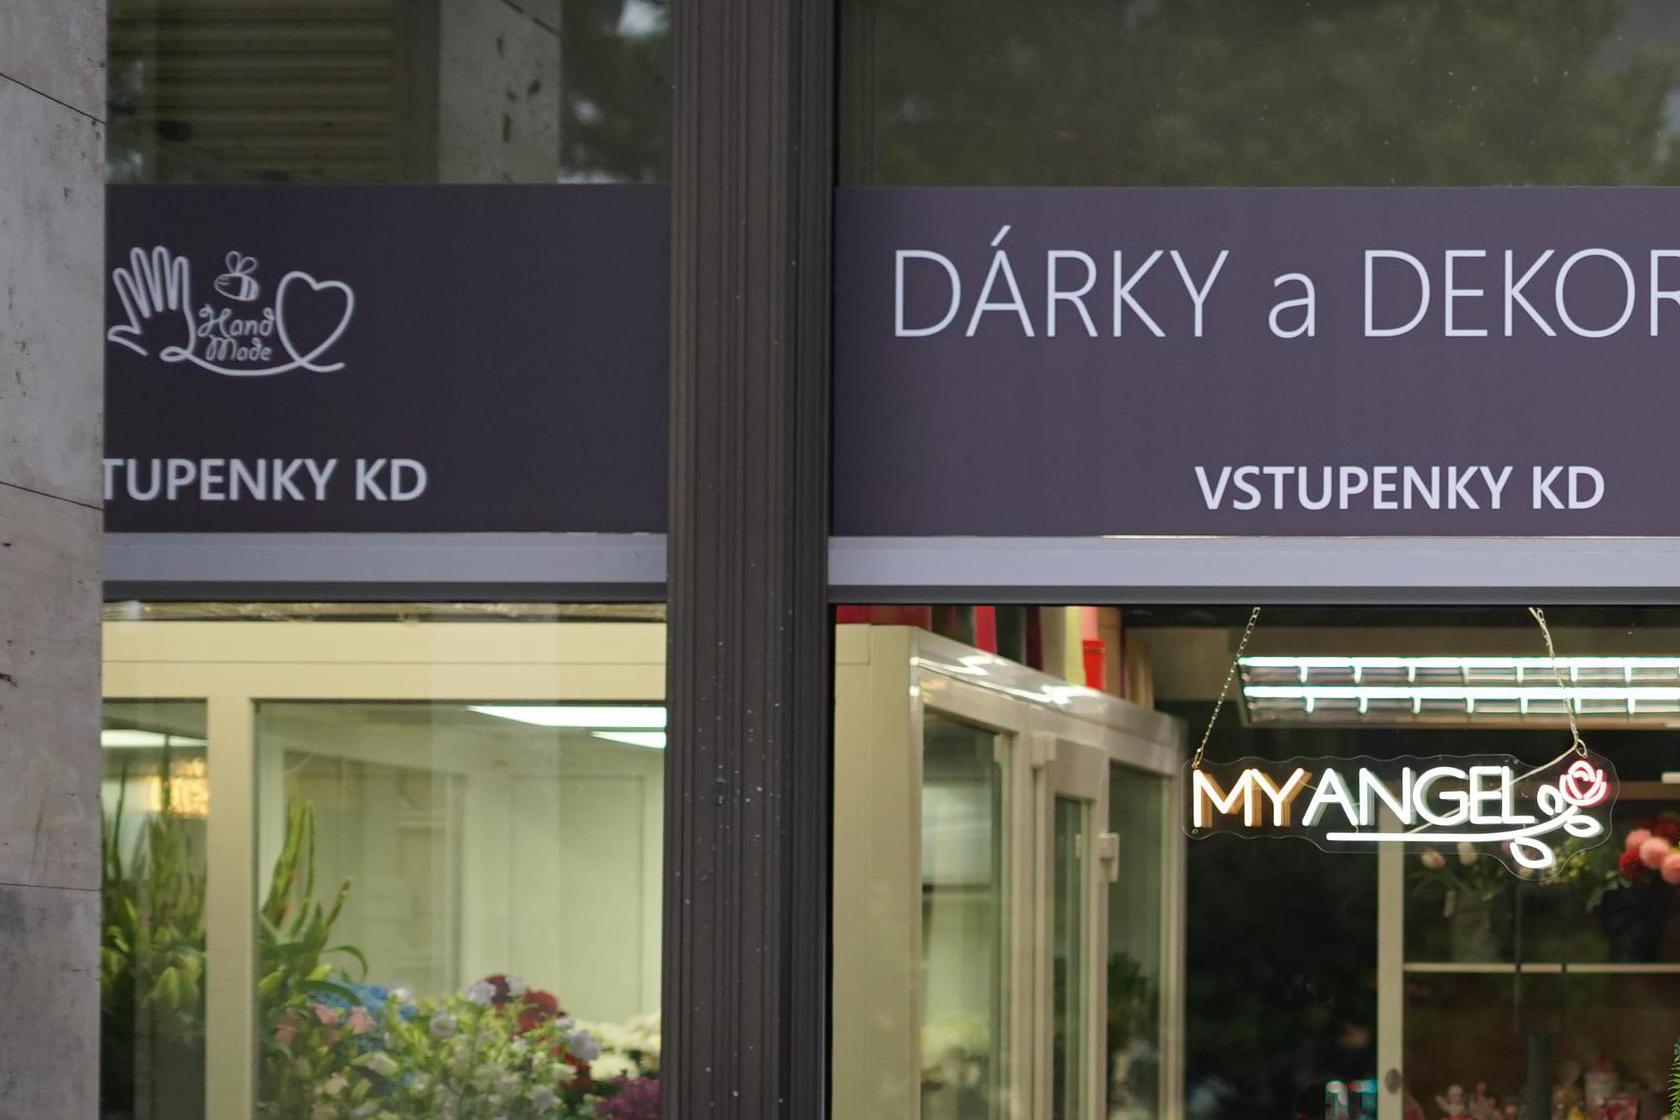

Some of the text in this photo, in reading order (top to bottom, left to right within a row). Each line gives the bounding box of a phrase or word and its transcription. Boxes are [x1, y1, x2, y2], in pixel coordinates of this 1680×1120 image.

[895, 225, 1229, 338] DÁRKY
[1267, 270, 1317, 338] a
[197, 303, 276, 337] Hand
[206, 335, 272, 361] Made
[355, 457, 428, 501] KD
[1194, 465, 1606, 511] VSTUPENKY KD
